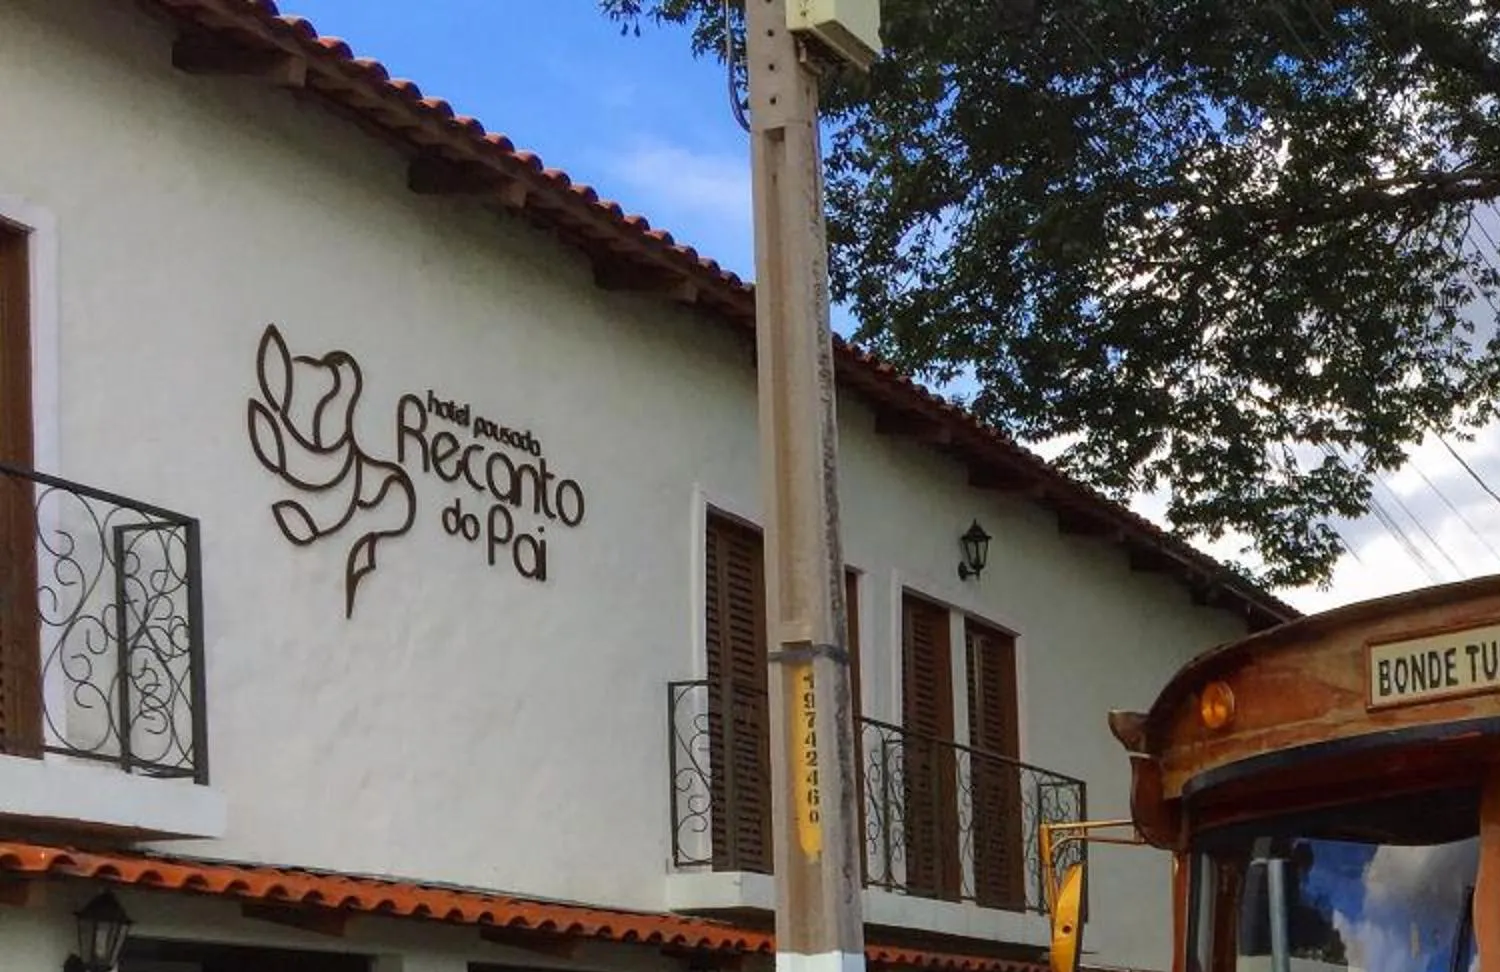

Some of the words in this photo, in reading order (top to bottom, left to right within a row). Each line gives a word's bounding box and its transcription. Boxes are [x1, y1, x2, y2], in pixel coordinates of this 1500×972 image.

[397, 393, 585, 527] Recanto
[427, 390, 470, 427] hotel
[473, 416, 541, 457] pousada
[441, 498, 480, 541] do
[487, 503, 547, 582] Pai
[1379, 647, 1459, 697] BONDE
